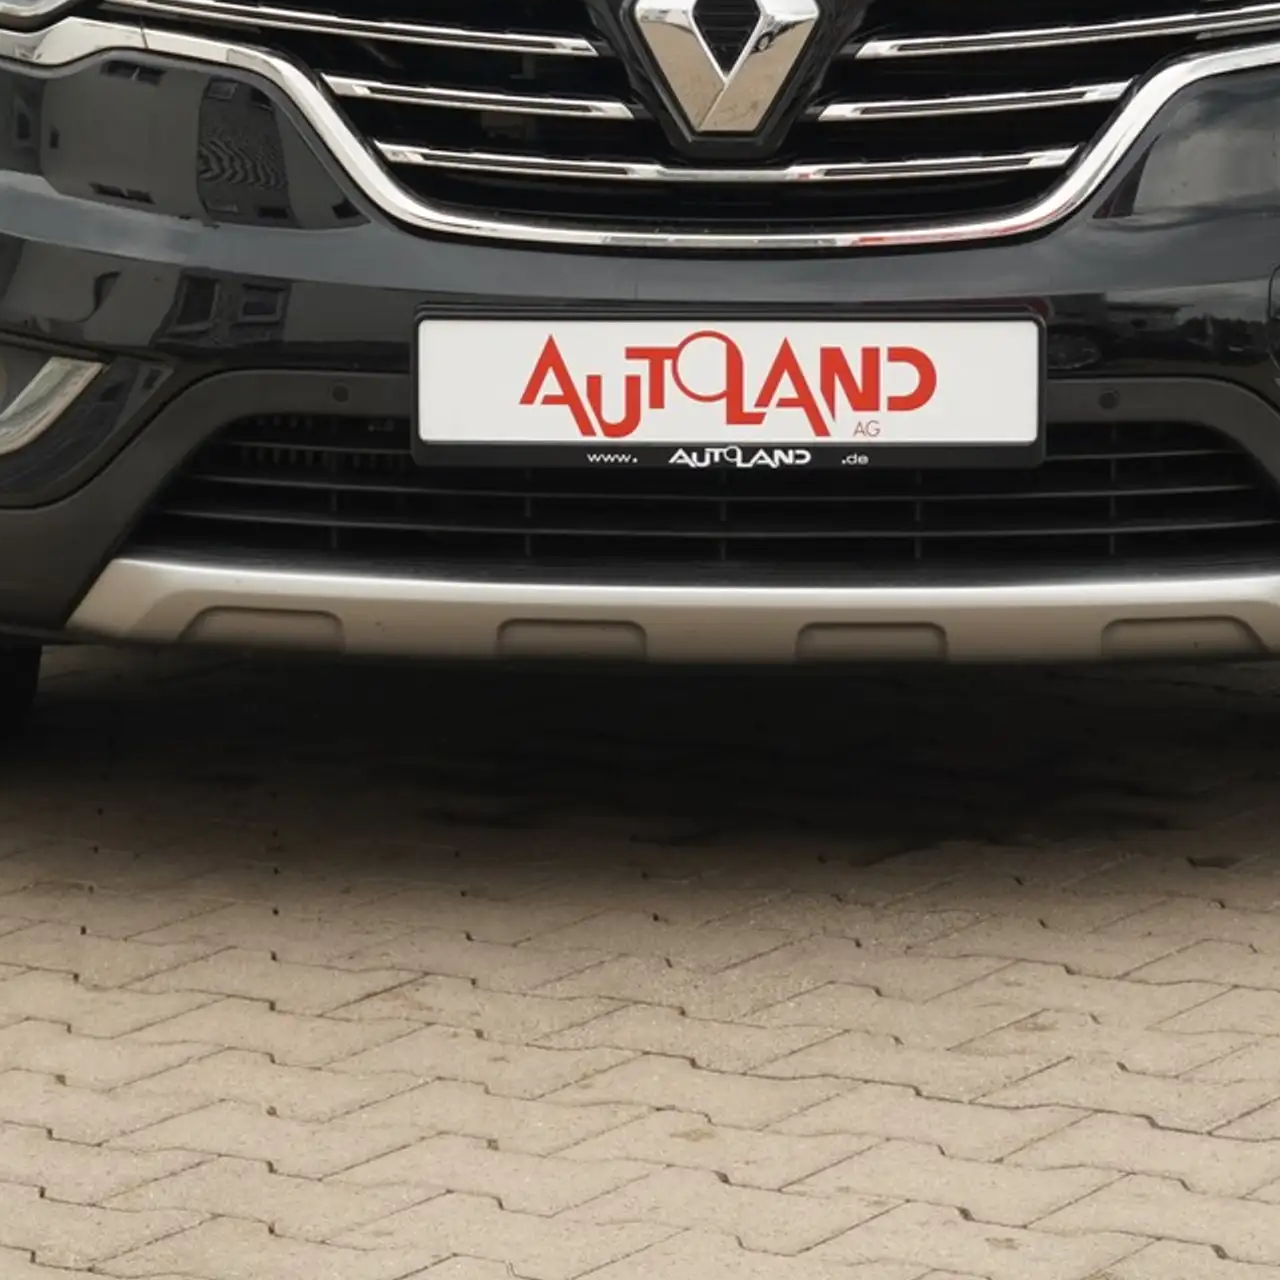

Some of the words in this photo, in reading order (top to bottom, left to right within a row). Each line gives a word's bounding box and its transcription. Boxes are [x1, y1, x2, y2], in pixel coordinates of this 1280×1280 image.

[519, 330, 937, 438] AUTOLAND
[852, 421, 881, 438] AG
[587, 452, 638, 464] www.
[669, 445, 812, 468] AUTOLAND
[841, 452, 870, 465] .de
